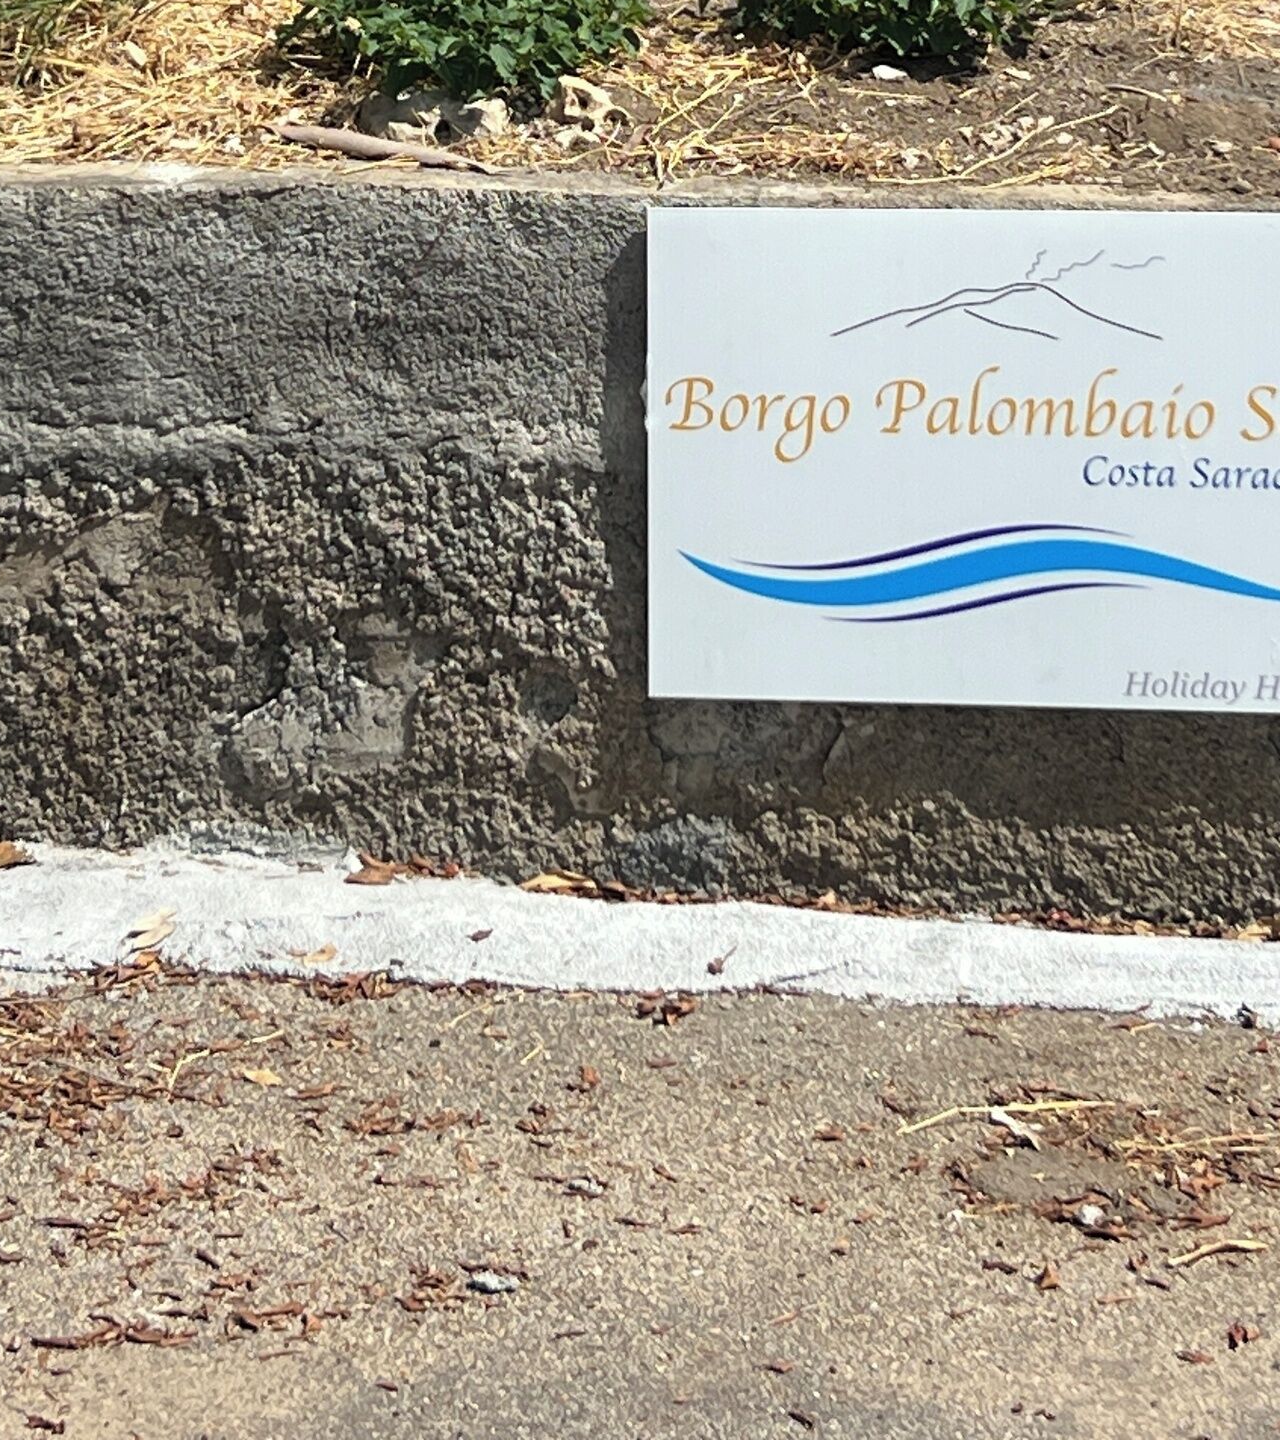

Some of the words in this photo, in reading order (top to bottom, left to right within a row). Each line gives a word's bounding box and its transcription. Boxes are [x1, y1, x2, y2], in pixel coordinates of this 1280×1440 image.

[665, 377, 851, 463] Borgo
[876, 366, 1216, 441] Palombaio
[1083, 455, 1177, 489] Costa
[1124, 671, 1246, 705] Holiday
